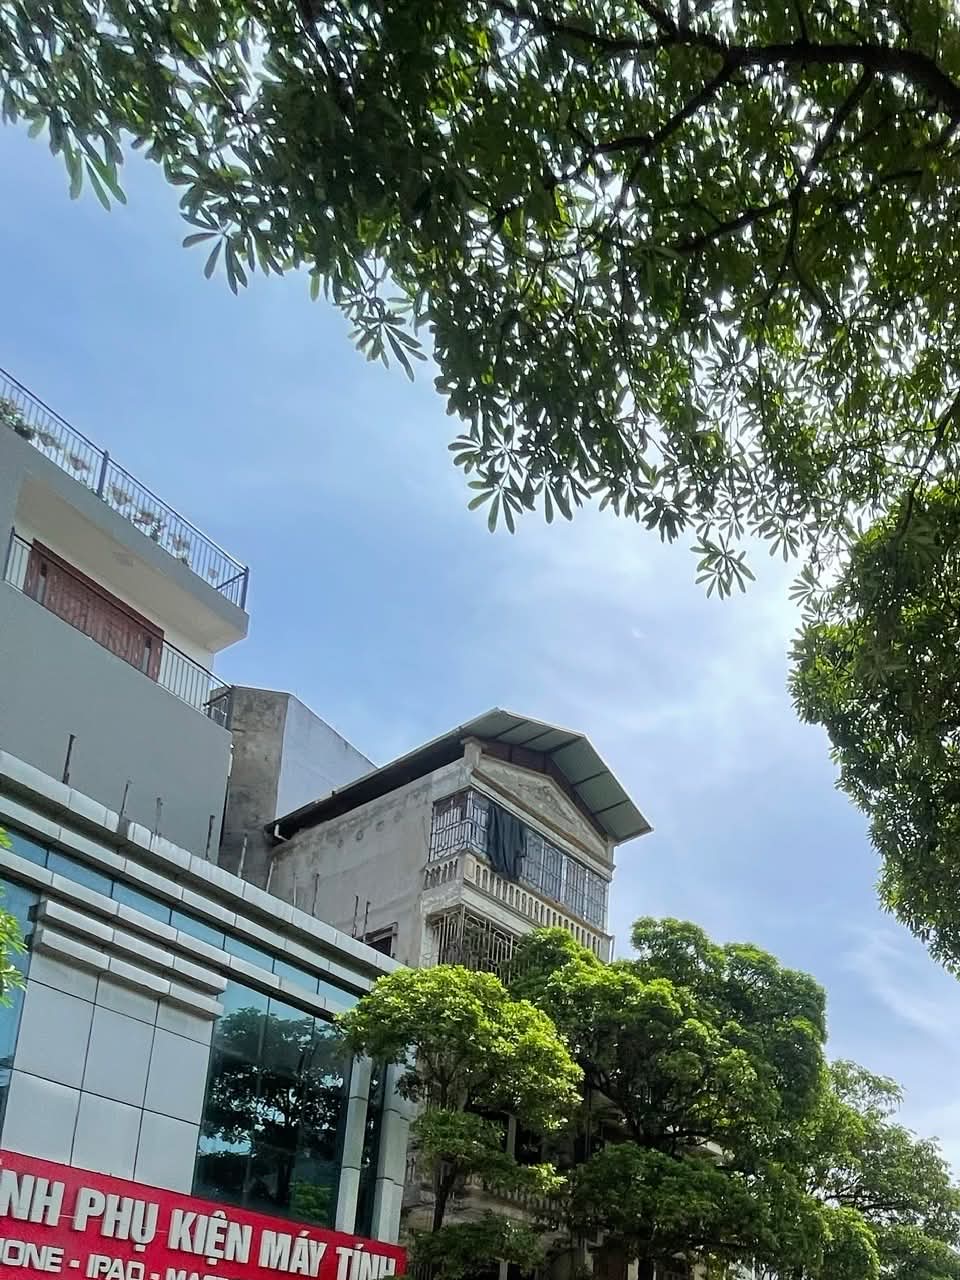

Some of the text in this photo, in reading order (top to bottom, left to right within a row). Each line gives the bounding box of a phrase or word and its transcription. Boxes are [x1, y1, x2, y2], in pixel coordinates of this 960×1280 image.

[73, 1187, 159, 1252] PHỤ
[168, 1208, 253, 1266] KIỆN
[258, 1229, 328, 1278] MÁY
